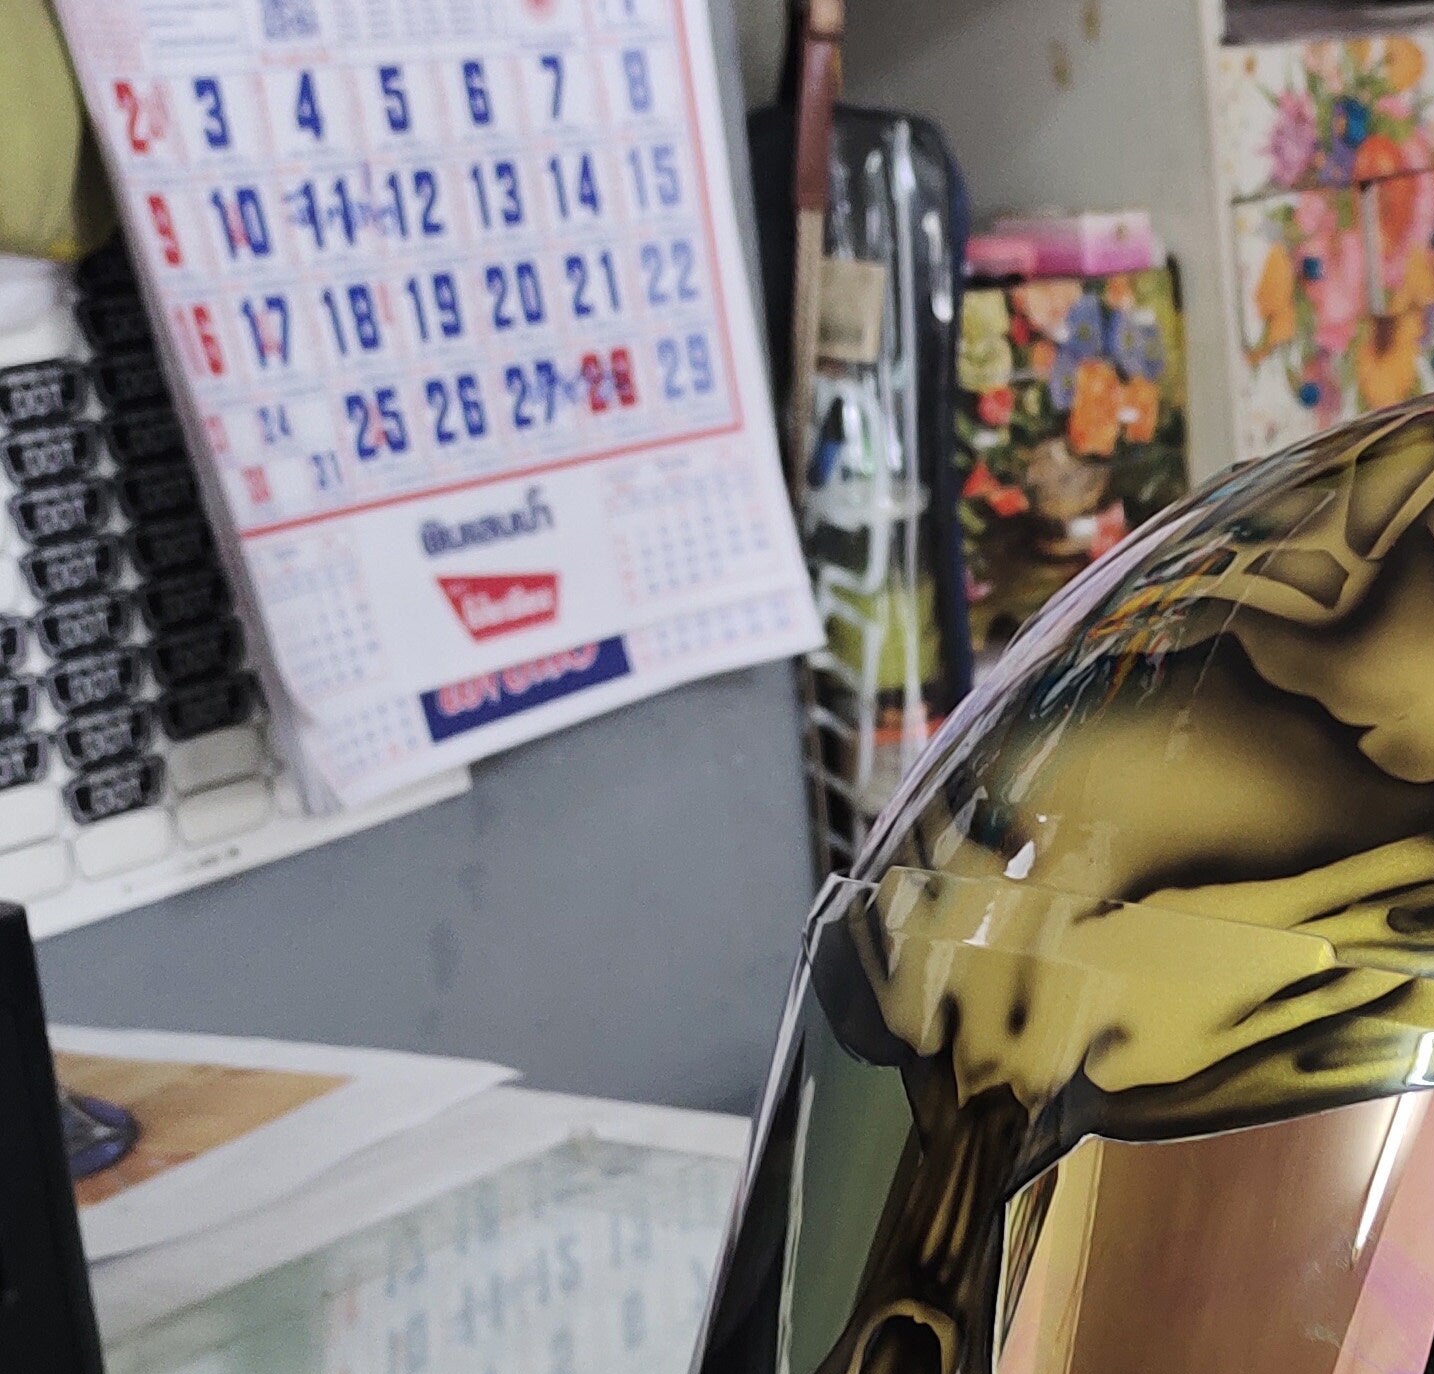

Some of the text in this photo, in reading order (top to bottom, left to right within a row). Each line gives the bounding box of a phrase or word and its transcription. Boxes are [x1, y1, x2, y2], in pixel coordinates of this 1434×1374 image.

[113, 49, 653, 153] 2 3 4 5 6 7 8
[147, 145, 681, 268] 9 10 11 12 13 14 15
[240, 295, 290, 371] 17
[321, 283, 381, 356] 18
[406, 272, 464, 343] 19
[485, 260, 546, 331] 20
[565, 250, 621, 320] 21
[641, 239, 700, 305] 22
[345, 386, 409, 462] 25
[425, 374, 488, 446] 26
[505, 359, 557, 430] 27
[580, 346, 638, 416] 28
[656, 332, 714, 400] 29
